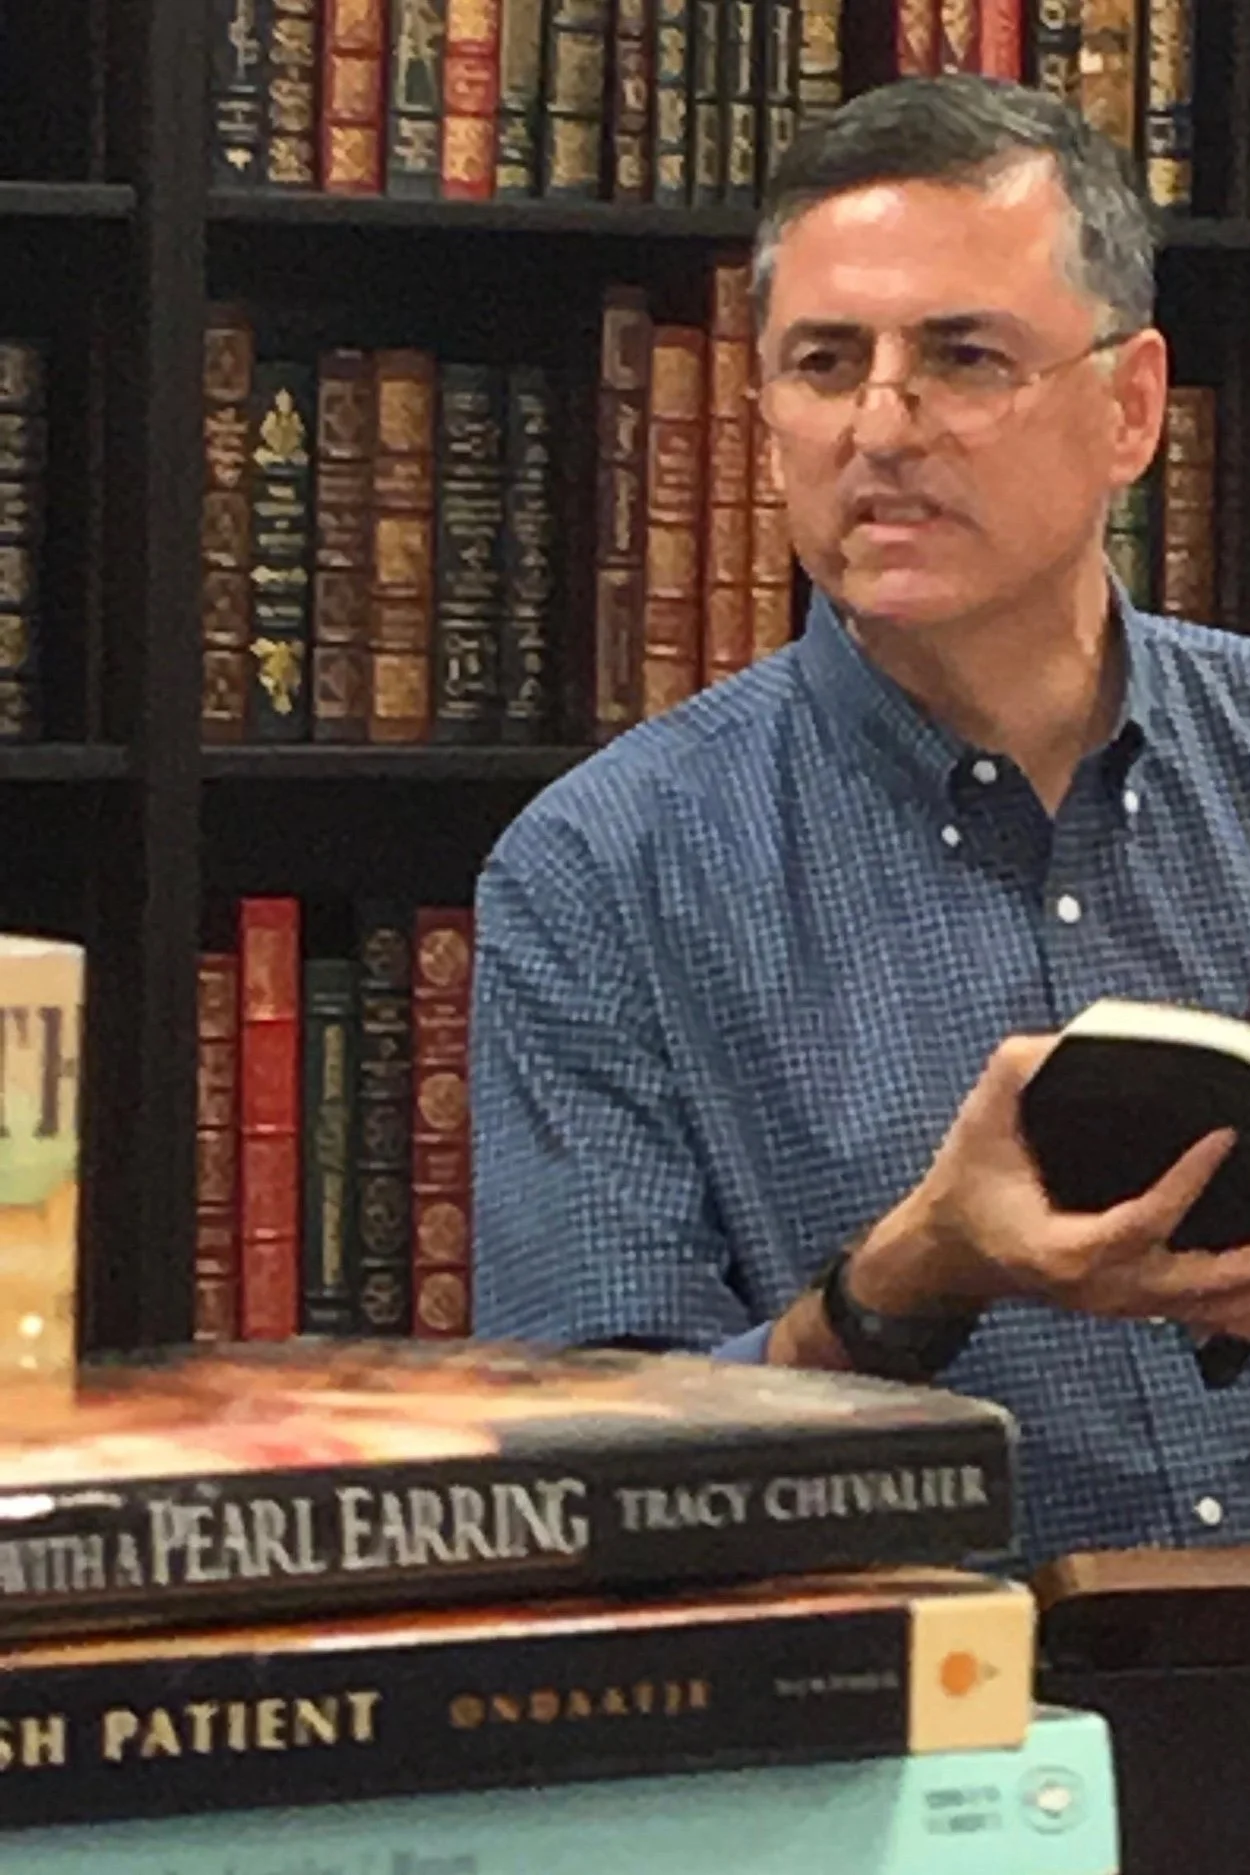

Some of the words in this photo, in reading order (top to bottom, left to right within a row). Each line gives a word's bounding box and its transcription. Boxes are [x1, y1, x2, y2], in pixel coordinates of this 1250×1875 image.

[115, 1532, 144, 1587] A
[147, 1497, 328, 1586] PEARL
[336, 1477, 590, 1571] EARRING
[614, 1482, 750, 1531] TRACY
[763, 1464, 989, 1521] CHEVALIER
[103, 1690, 382, 1763] PATIENT
